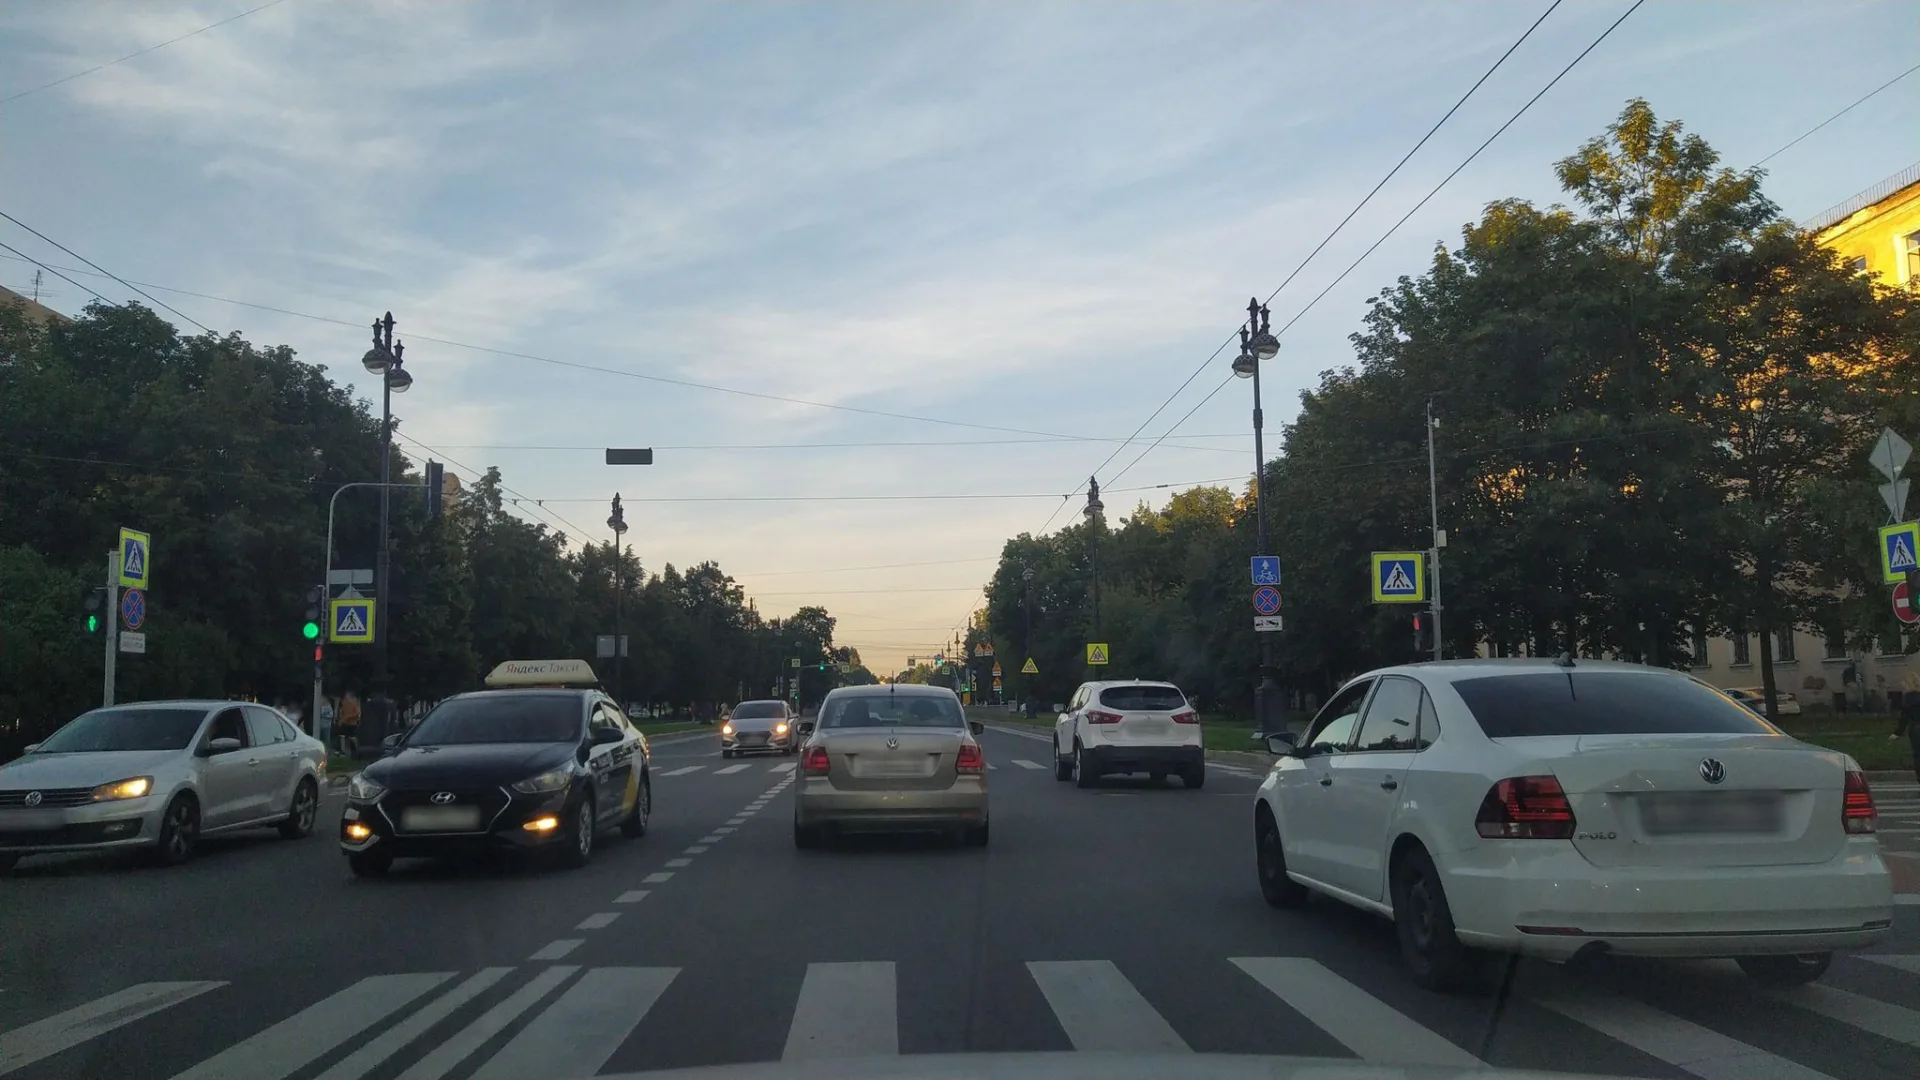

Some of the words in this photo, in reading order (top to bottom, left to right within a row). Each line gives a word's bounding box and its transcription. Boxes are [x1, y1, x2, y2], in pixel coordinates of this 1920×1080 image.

[506, 662, 545, 675] Яндекс
[549, 662, 579, 673] Такси
[1578, 832, 1617, 840] POLO
